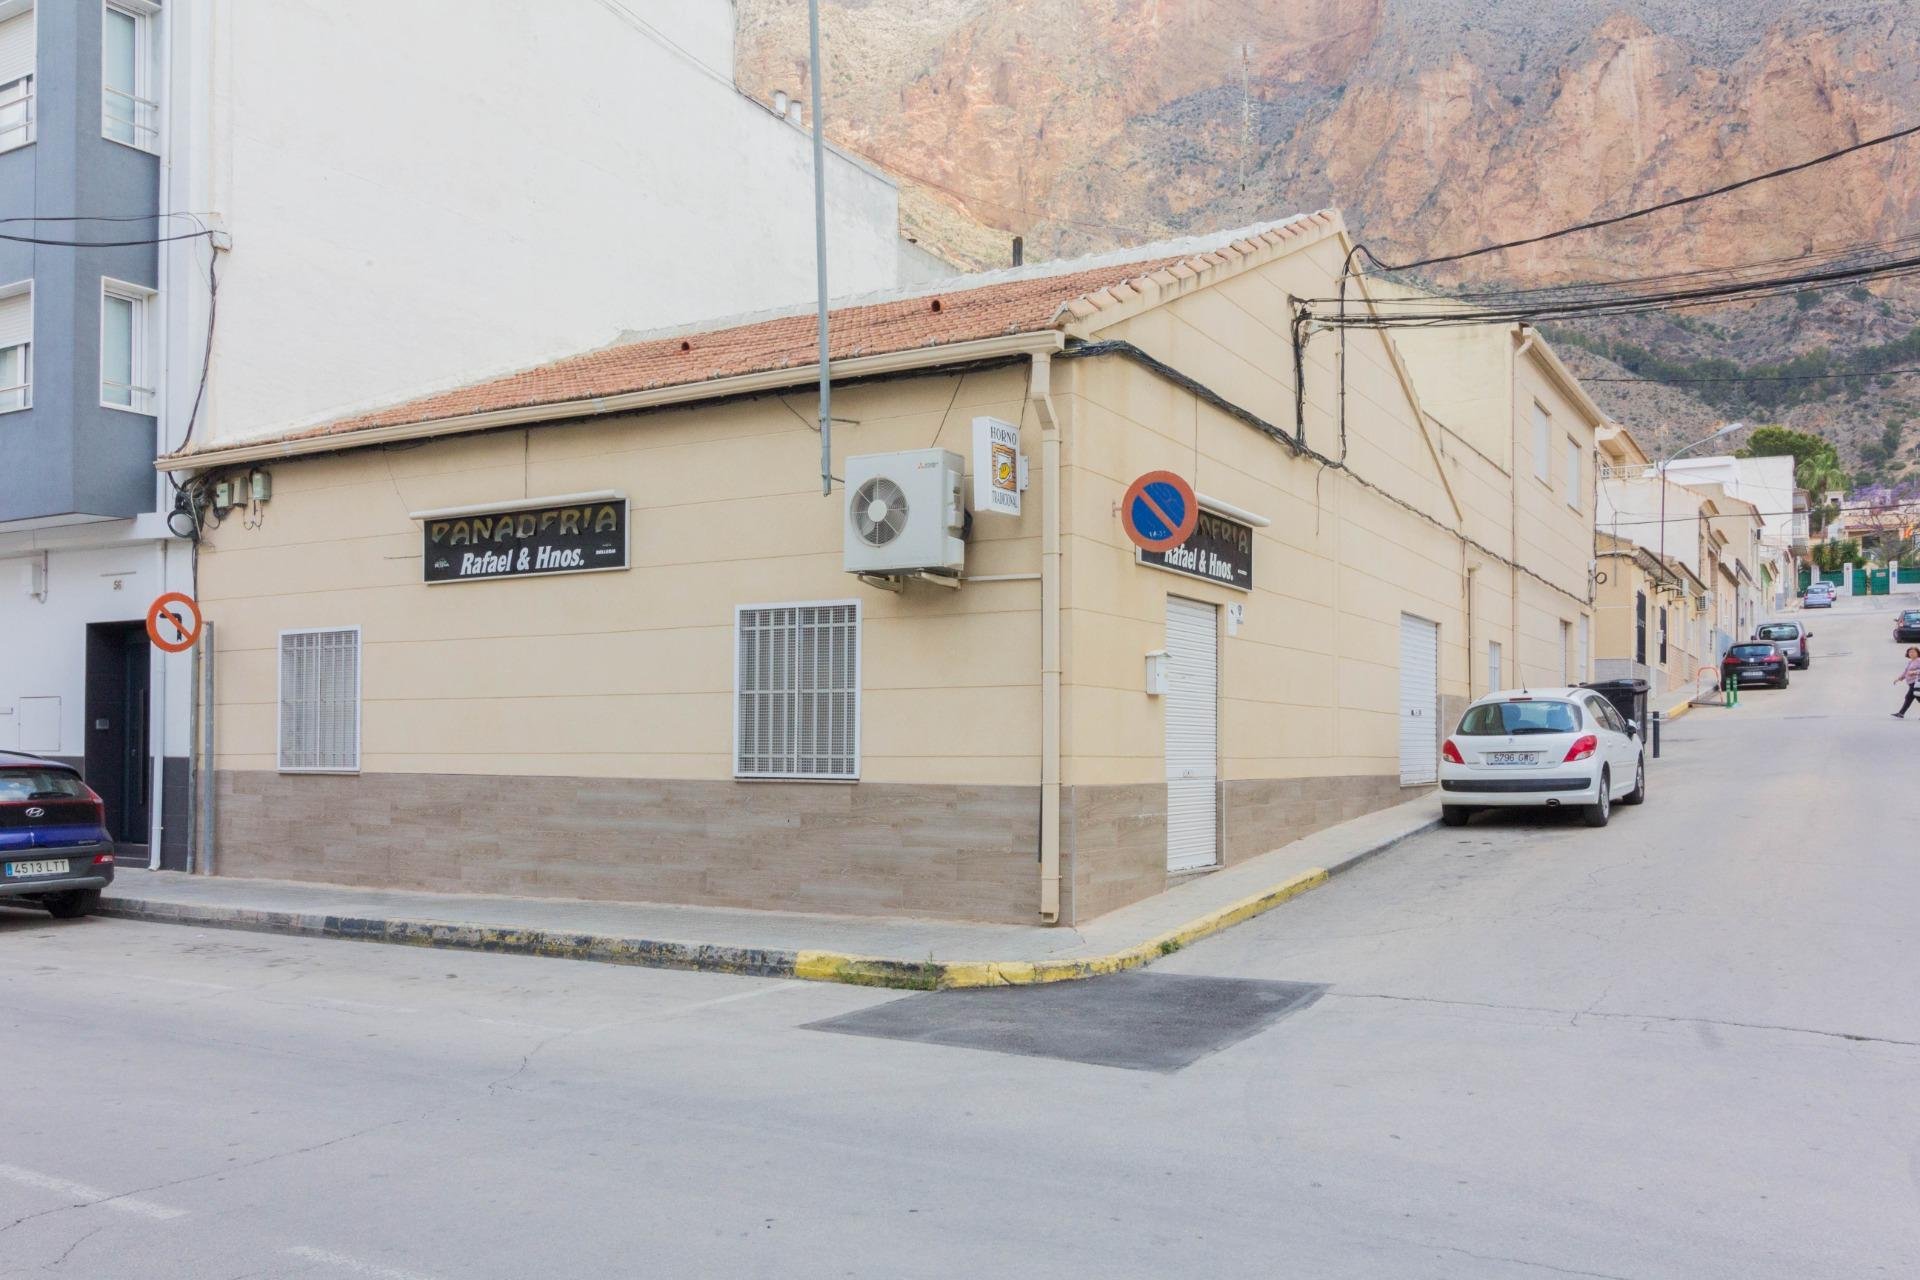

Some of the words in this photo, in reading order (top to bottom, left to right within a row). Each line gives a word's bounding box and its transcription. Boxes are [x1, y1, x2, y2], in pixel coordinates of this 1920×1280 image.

[990, 426, 1017, 445] HORNO
[460, 548, 513, 576] Rafael
[516, 547, 530, 571] &
[535, 545, 585, 569] Hnos.
[1198, 549, 1207, 573] &
[1208, 552, 1234, 581] Hnos.
[1494, 753, 1515, 762] 5796
[15, 862, 42, 873] 4513
[46, 860, 66, 871] LTT
